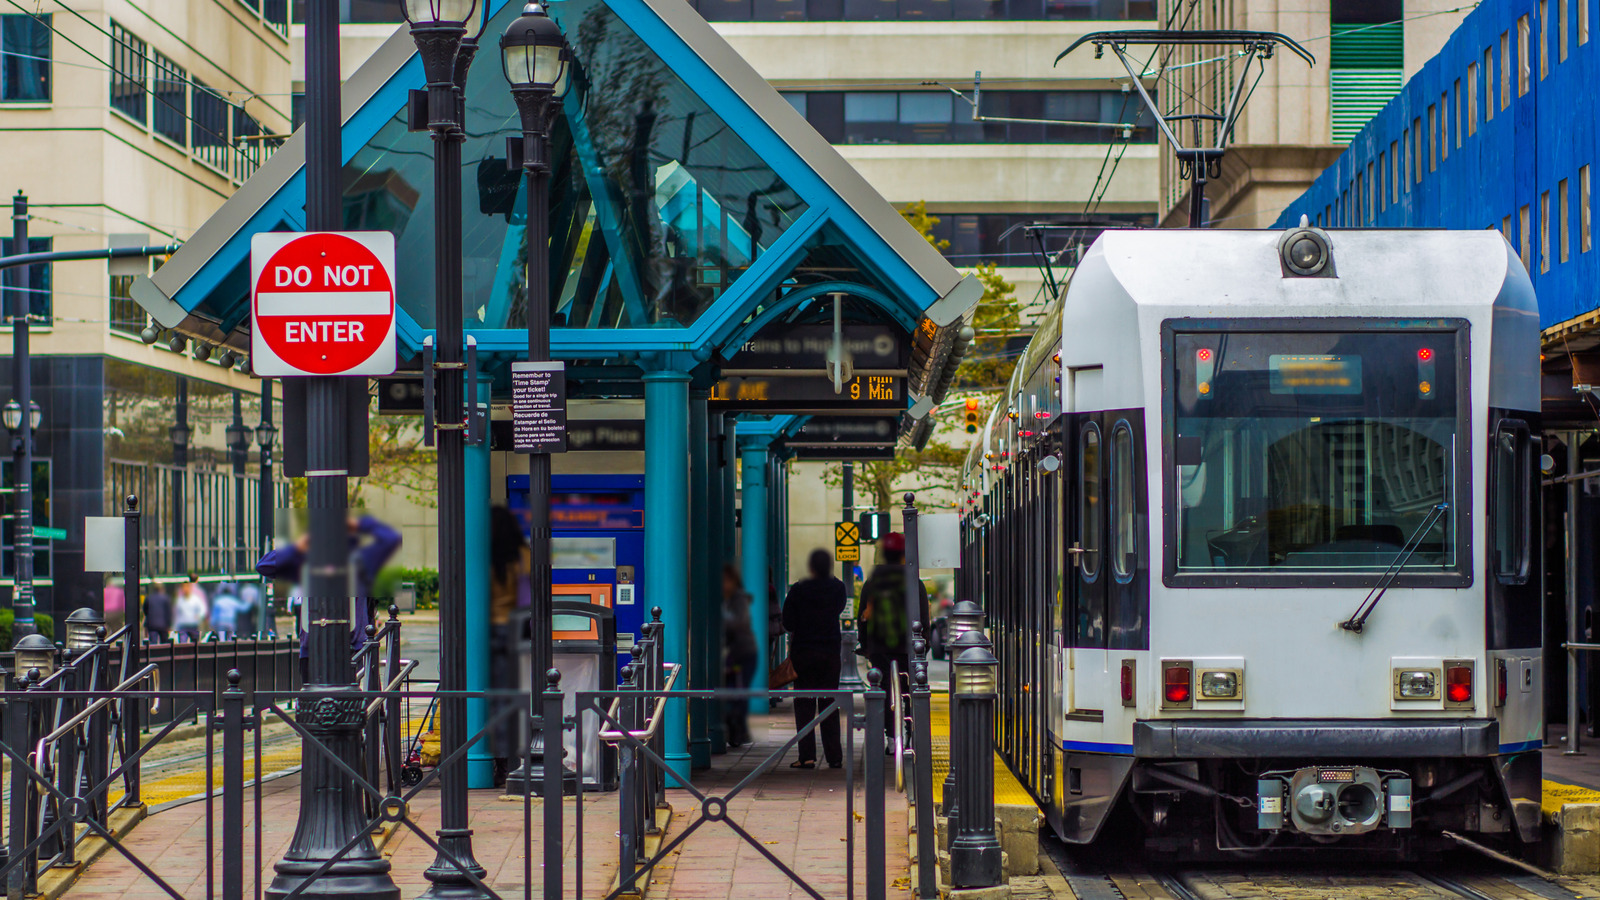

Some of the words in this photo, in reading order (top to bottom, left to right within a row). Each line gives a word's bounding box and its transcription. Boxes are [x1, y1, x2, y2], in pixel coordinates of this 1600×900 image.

[275, 265, 312, 287] DO
[324, 265, 374, 286] NOT
[285, 321, 364, 342] ENTER
[850, 383, 860, 400] 9
[868, 383, 893, 400] Min
